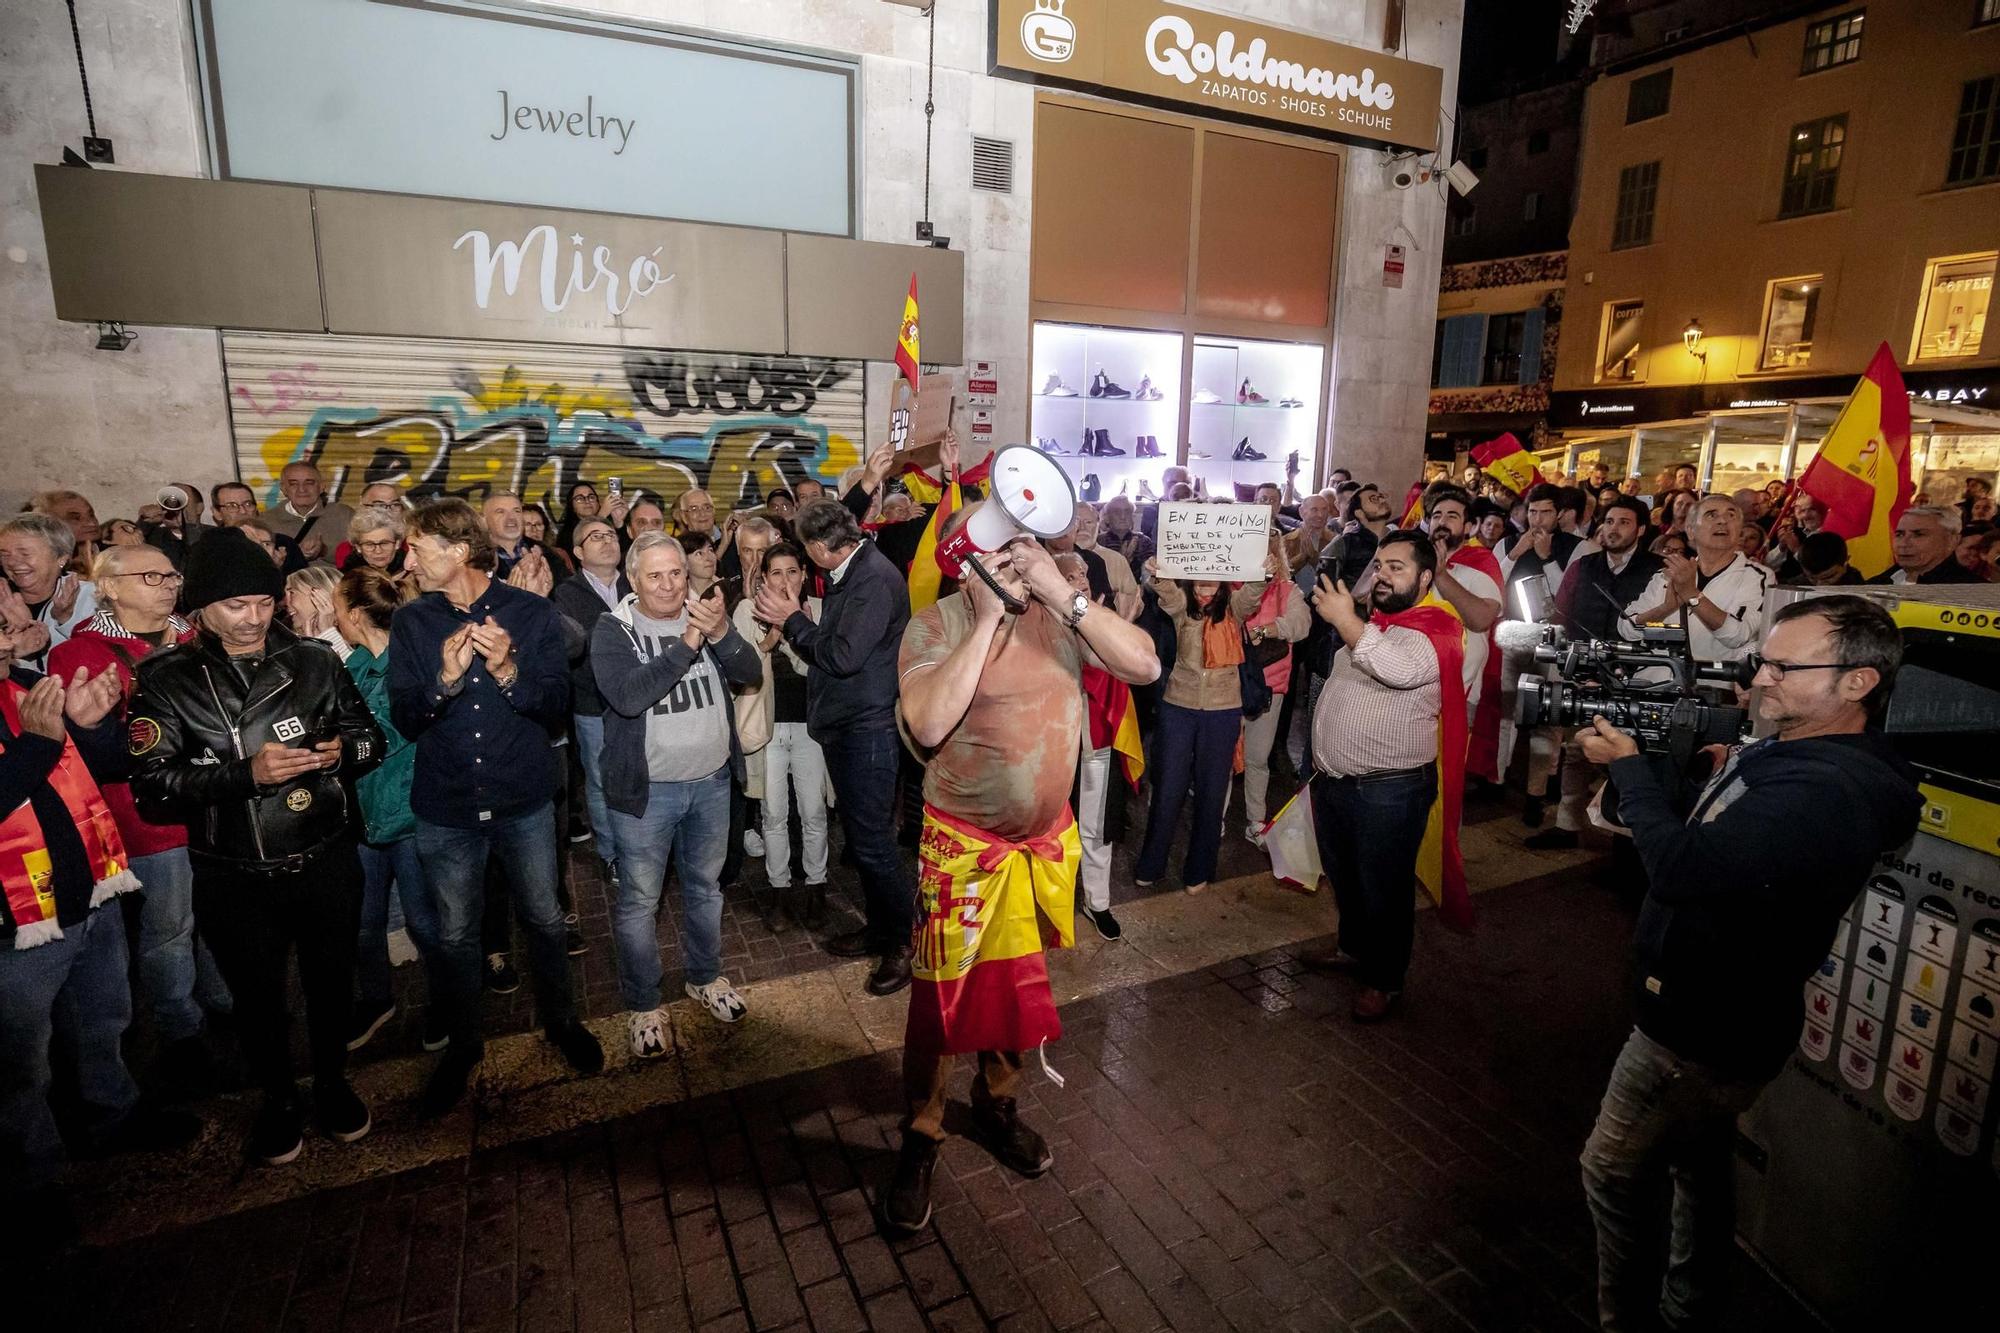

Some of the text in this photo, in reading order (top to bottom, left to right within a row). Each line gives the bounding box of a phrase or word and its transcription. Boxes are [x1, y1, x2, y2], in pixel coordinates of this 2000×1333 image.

[1145, 15, 1394, 110] Goldmarie
[490, 90, 635, 155] Jewelry
[1201, 80, 1392, 131] ZAPATOS SHOES SCHUHE
[453, 225, 675, 315] Miró
[1938, 277, 1991, 293] COFFEE
[1169, 511, 1188, 523] EN
[277, 720, 303, 738] 66
[1927, 870, 1955, 891] de
